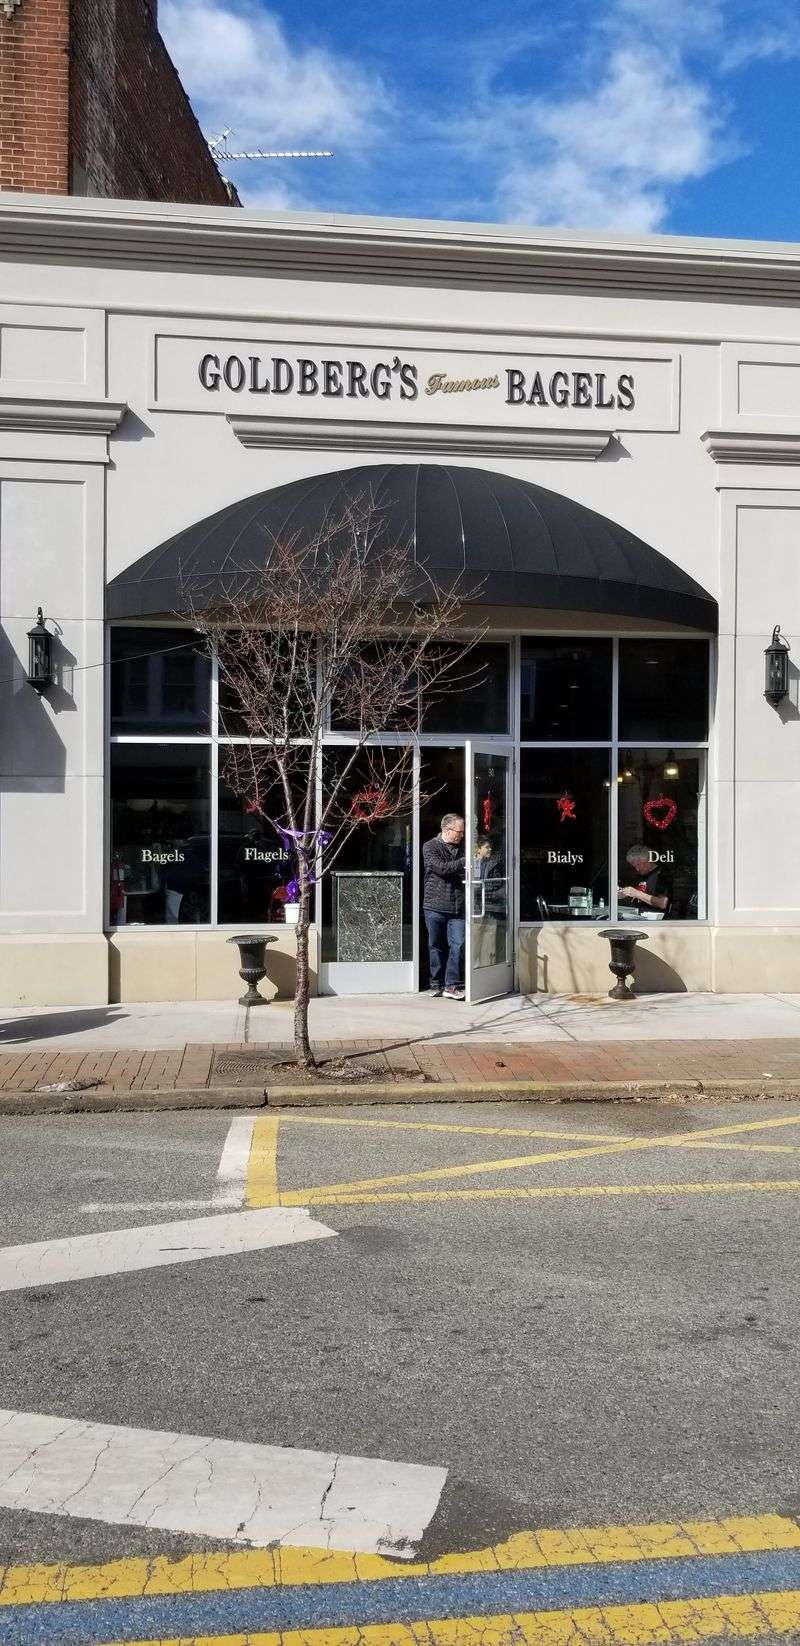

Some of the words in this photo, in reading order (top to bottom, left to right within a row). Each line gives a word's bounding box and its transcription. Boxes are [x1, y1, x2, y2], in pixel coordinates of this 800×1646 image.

[198, 353, 419, 401] GOLDBERG'S
[425, 373, 501, 395] Famous
[505, 368, 635, 411] BAGELS
[141, 849, 185, 864] Bagels
[244, 847, 289, 862] Flagels
[547, 851, 584, 866] Bialys
[648, 850, 674, 863] Deli
